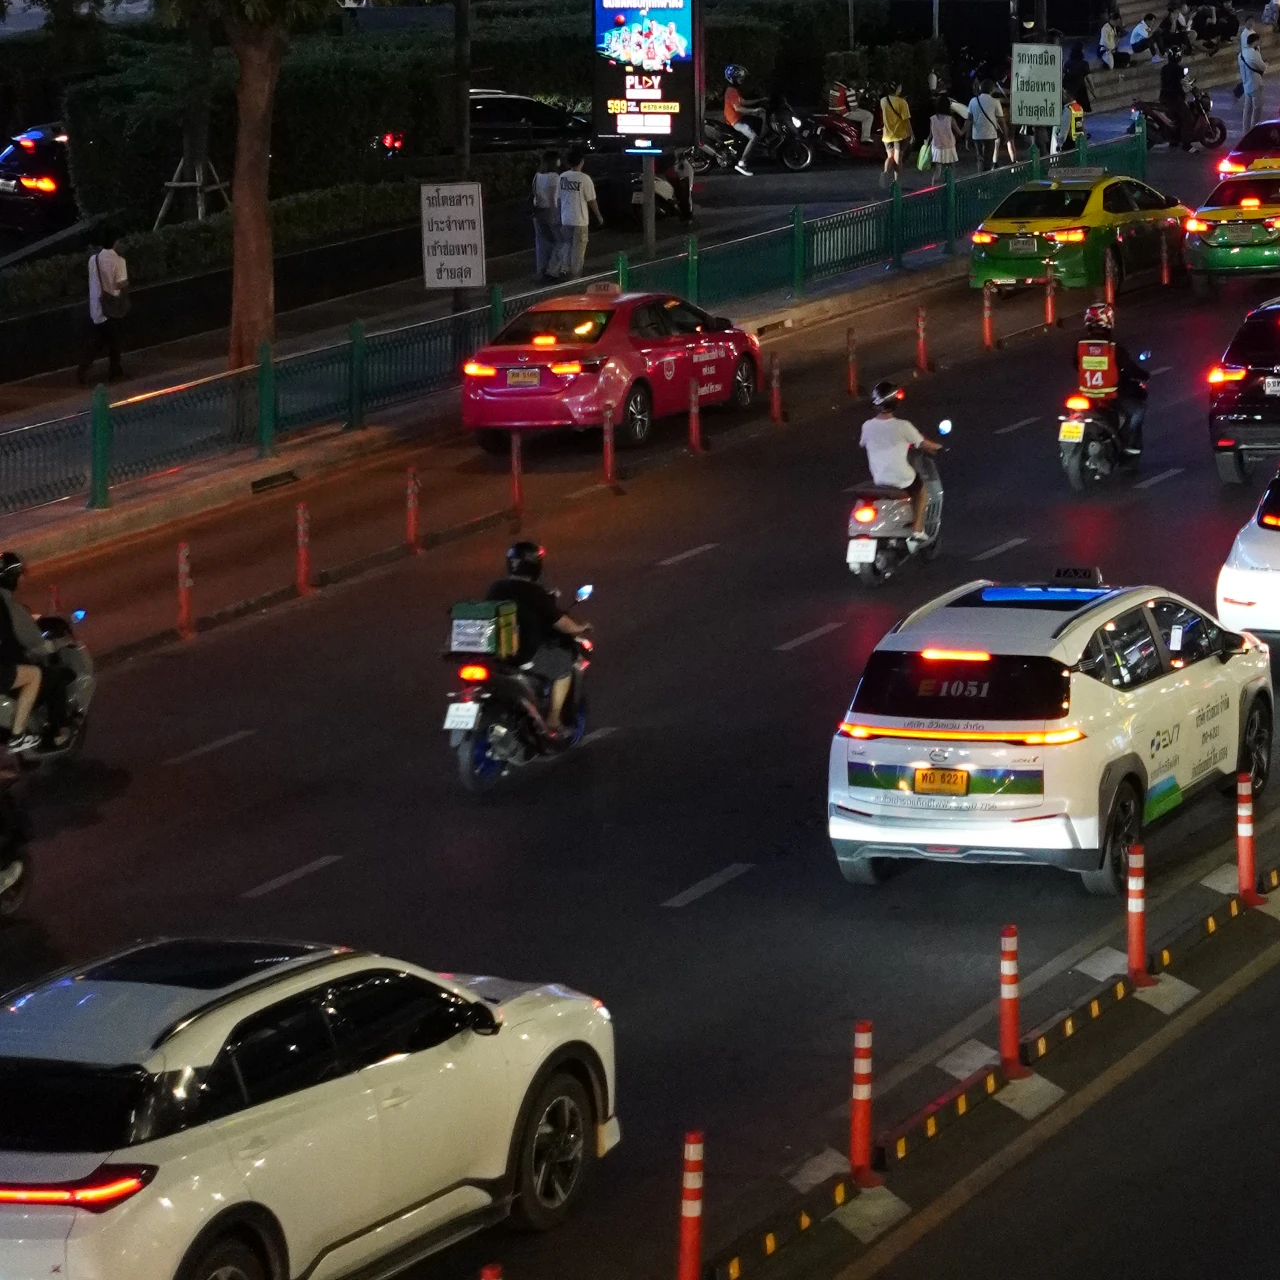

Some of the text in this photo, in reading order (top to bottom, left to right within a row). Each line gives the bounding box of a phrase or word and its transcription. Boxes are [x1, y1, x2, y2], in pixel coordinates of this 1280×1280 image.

[608, 100, 627, 114] 599
[425, 189, 475, 208] รถโดยสาร
[427, 217, 476, 233] ประจำทาง
[1085, 371, 1104, 387] 14
[1055, 567, 1092, 579] TAXI
[939, 680, 990, 698] 1051
[940, 773, 965, 785] 6221
